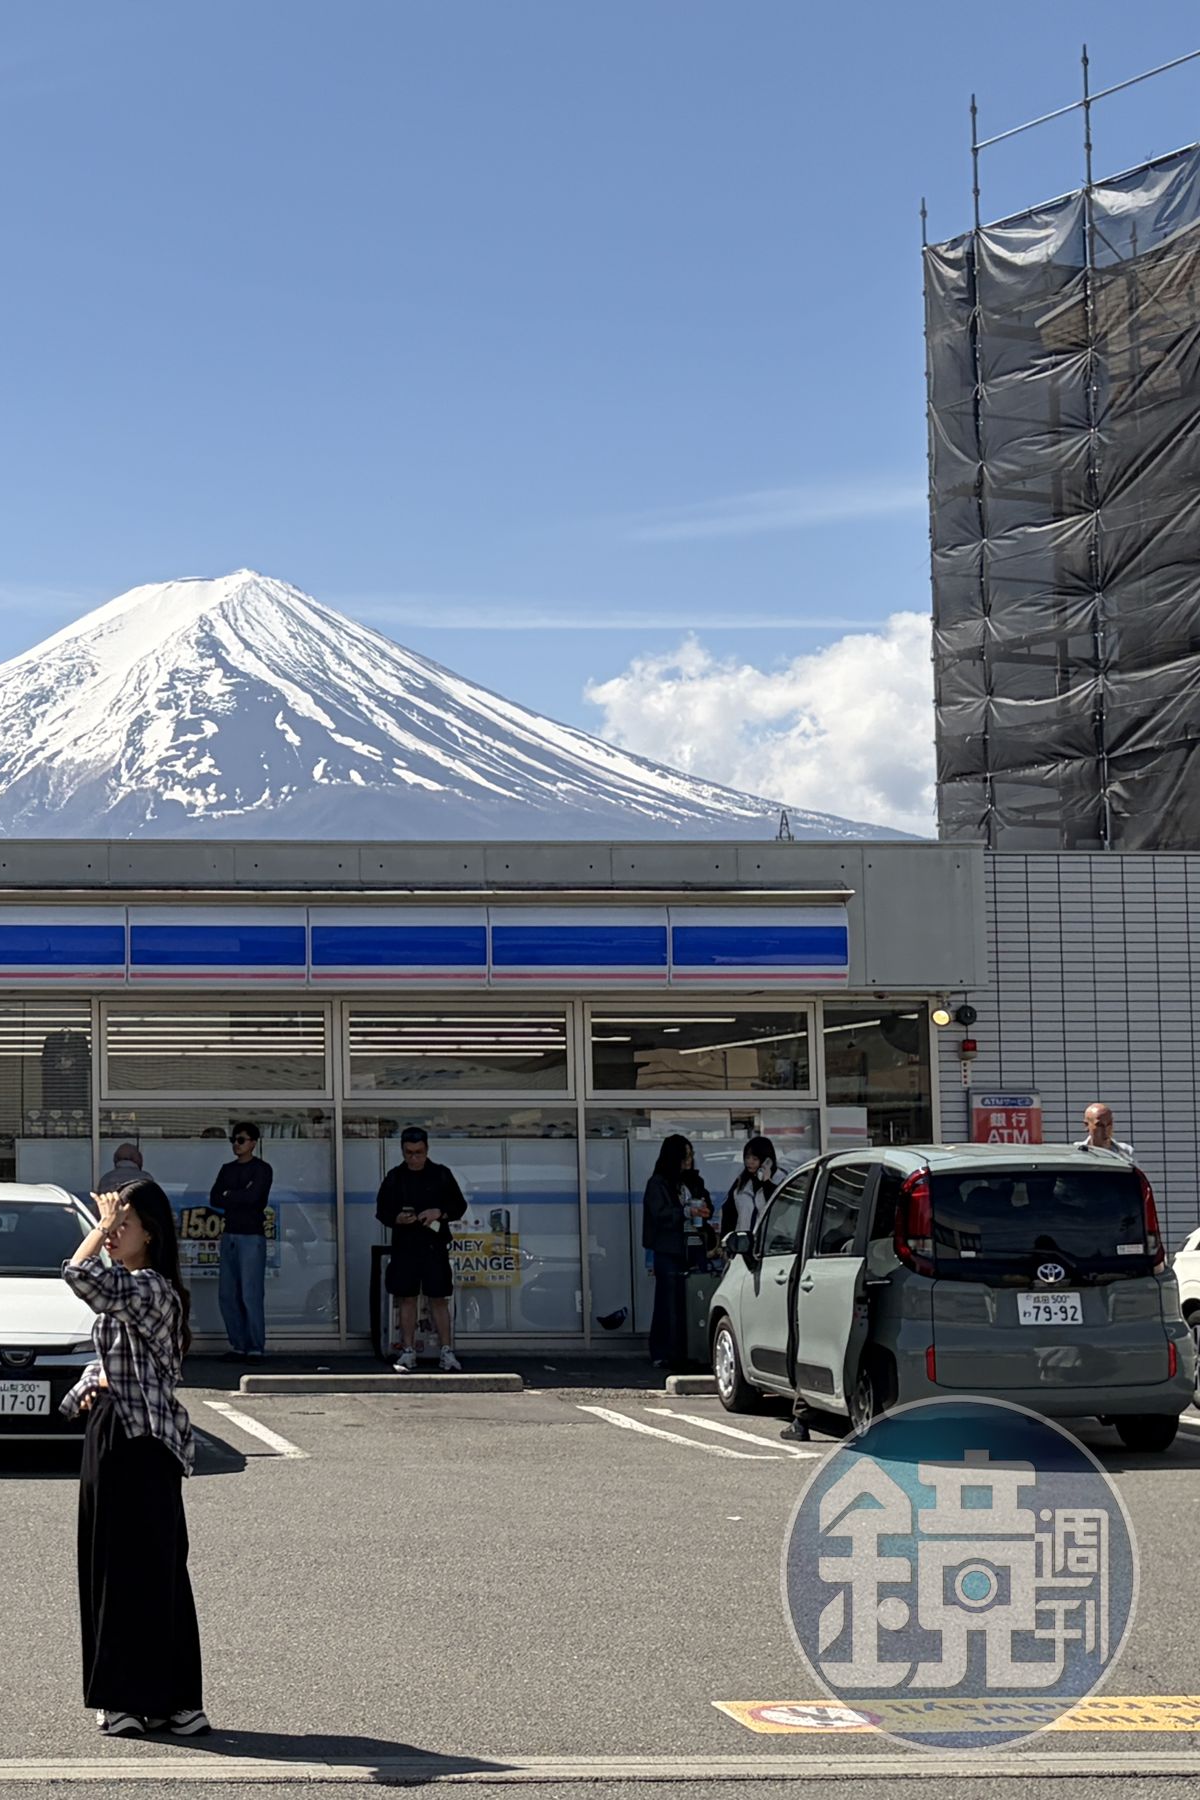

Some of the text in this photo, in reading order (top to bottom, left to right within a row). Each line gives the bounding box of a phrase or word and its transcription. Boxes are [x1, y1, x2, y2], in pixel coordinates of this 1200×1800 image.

[990, 1112, 1028, 1127] 銀行
[988, 1129, 1030, 1144] ATM
[446, 1240, 484, 1251] ONEY
[453, 1257, 515, 1271] HANGE
[1051, 1294, 1067, 1304] 500
[1023, 1305, 1079, 1322] わ 79-92
[0, 1383, 36, 1392] 山梨 300
[1, 1394, 46, 1411] 17-07
